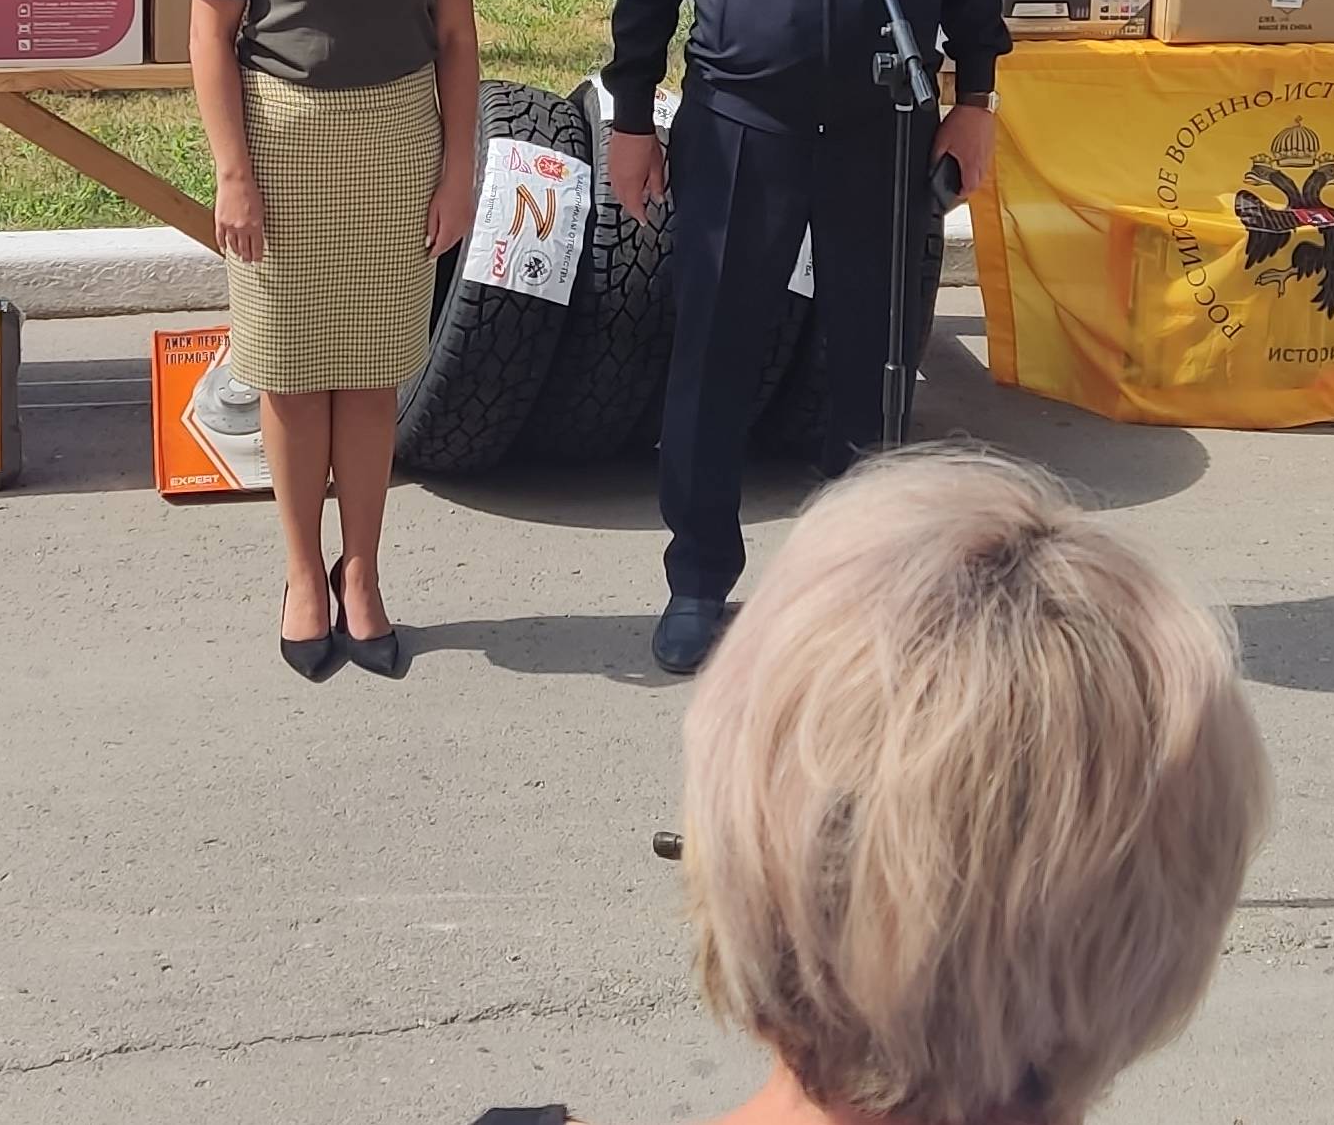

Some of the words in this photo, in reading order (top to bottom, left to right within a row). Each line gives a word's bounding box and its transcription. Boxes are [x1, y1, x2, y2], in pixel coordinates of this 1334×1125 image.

[558, 232, 576, 285] ОТЕЧЕСТВА
[1156, 167, 1245, 342] РОССИЙСОЕ
[165, 336, 194, 352] ДИСК
[197, 334, 232, 348] ПЕРЕД
[165, 351, 217, 365] ТОРМОЗА
[170, 474, 220, 487] EXPERT
